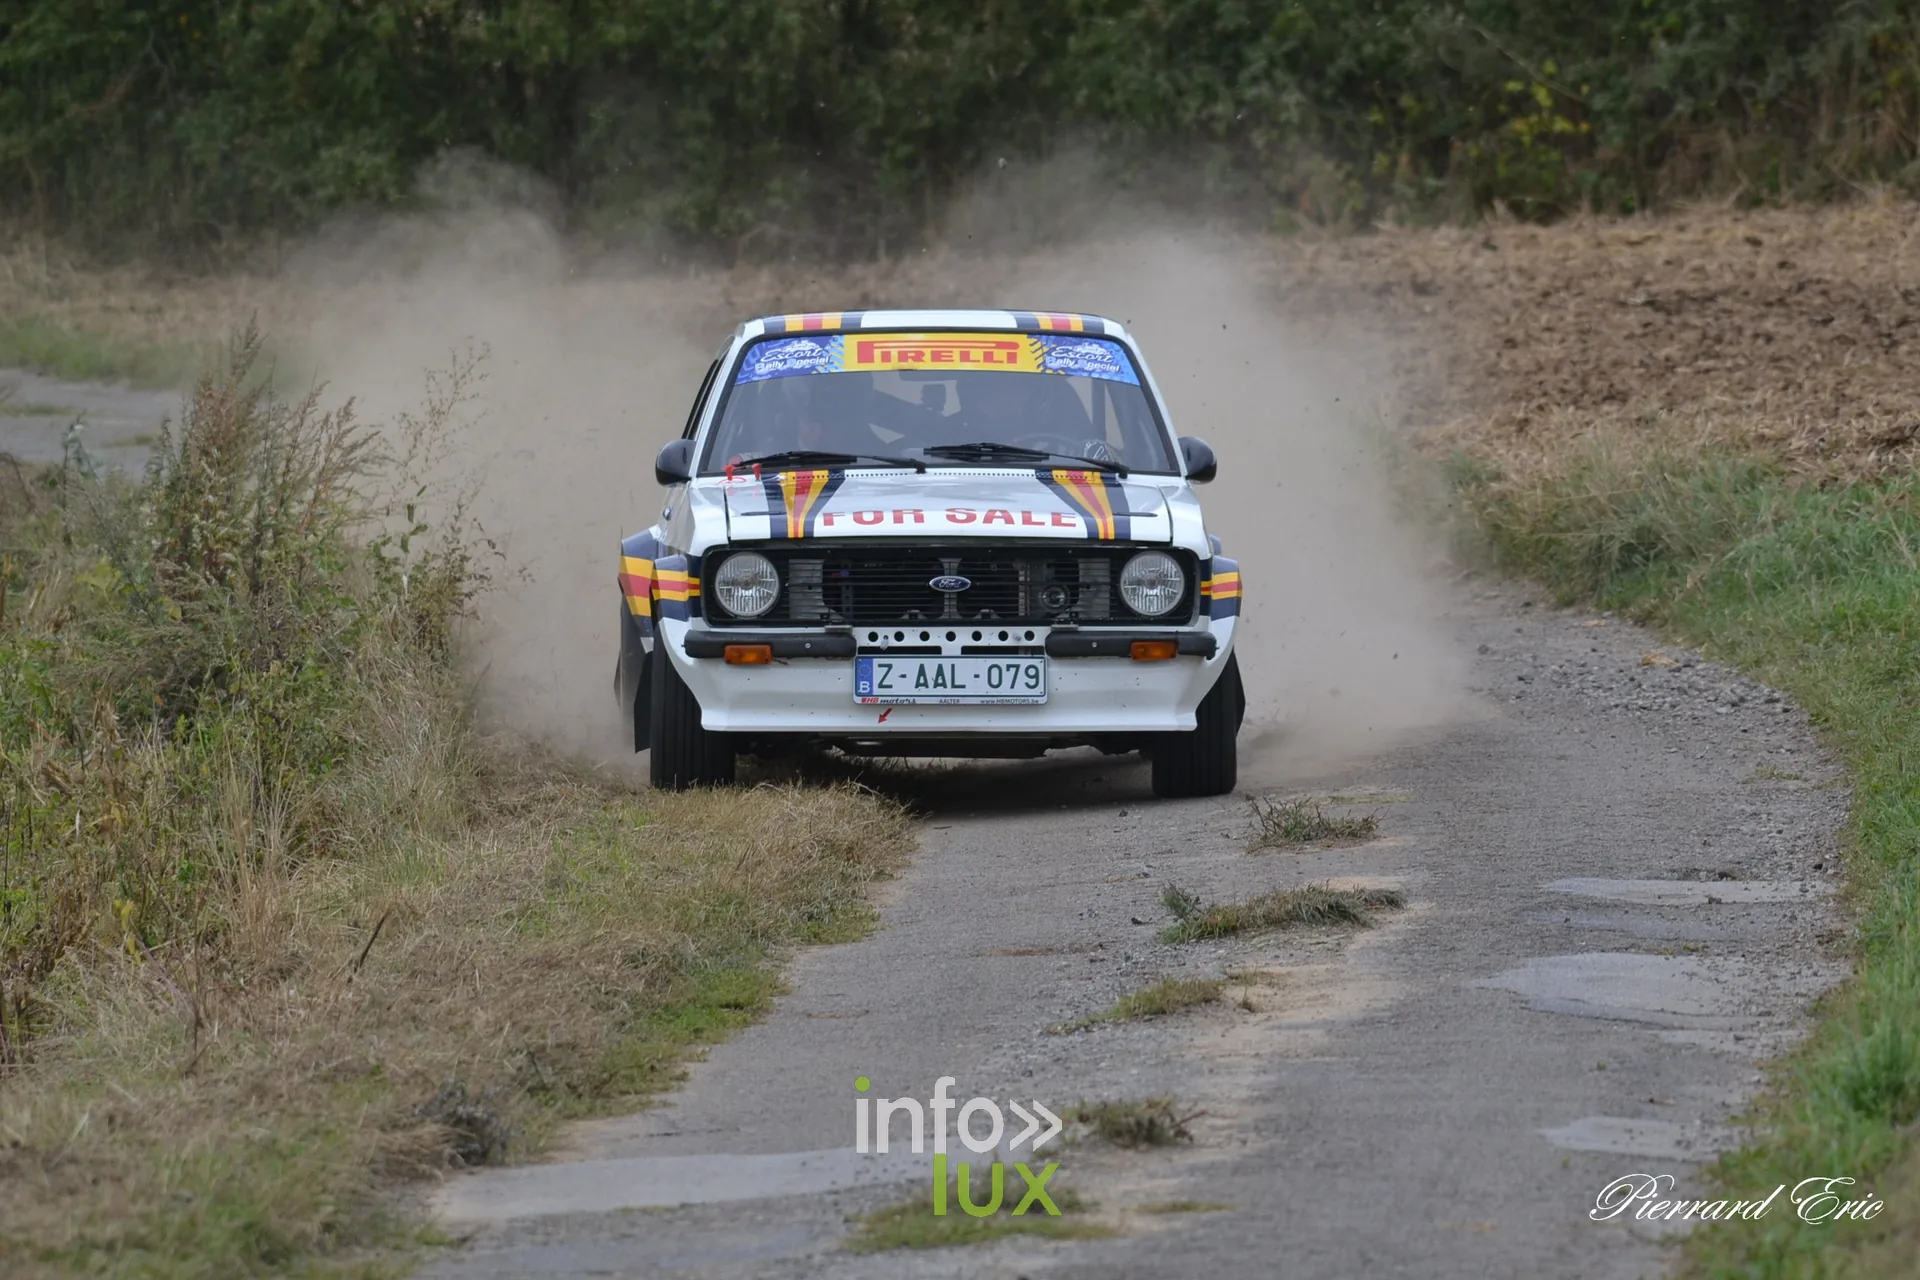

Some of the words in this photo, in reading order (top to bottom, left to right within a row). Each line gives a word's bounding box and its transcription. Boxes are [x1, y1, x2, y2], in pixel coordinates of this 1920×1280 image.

[760, 348, 825, 362] Escort
[857, 340, 1020, 364] PIRELLI
[1051, 345, 1114, 363] Escort
[823, 508, 925, 526] FOR
[945, 508, 1077, 527] SALE
[859, 681, 870, 693] B
